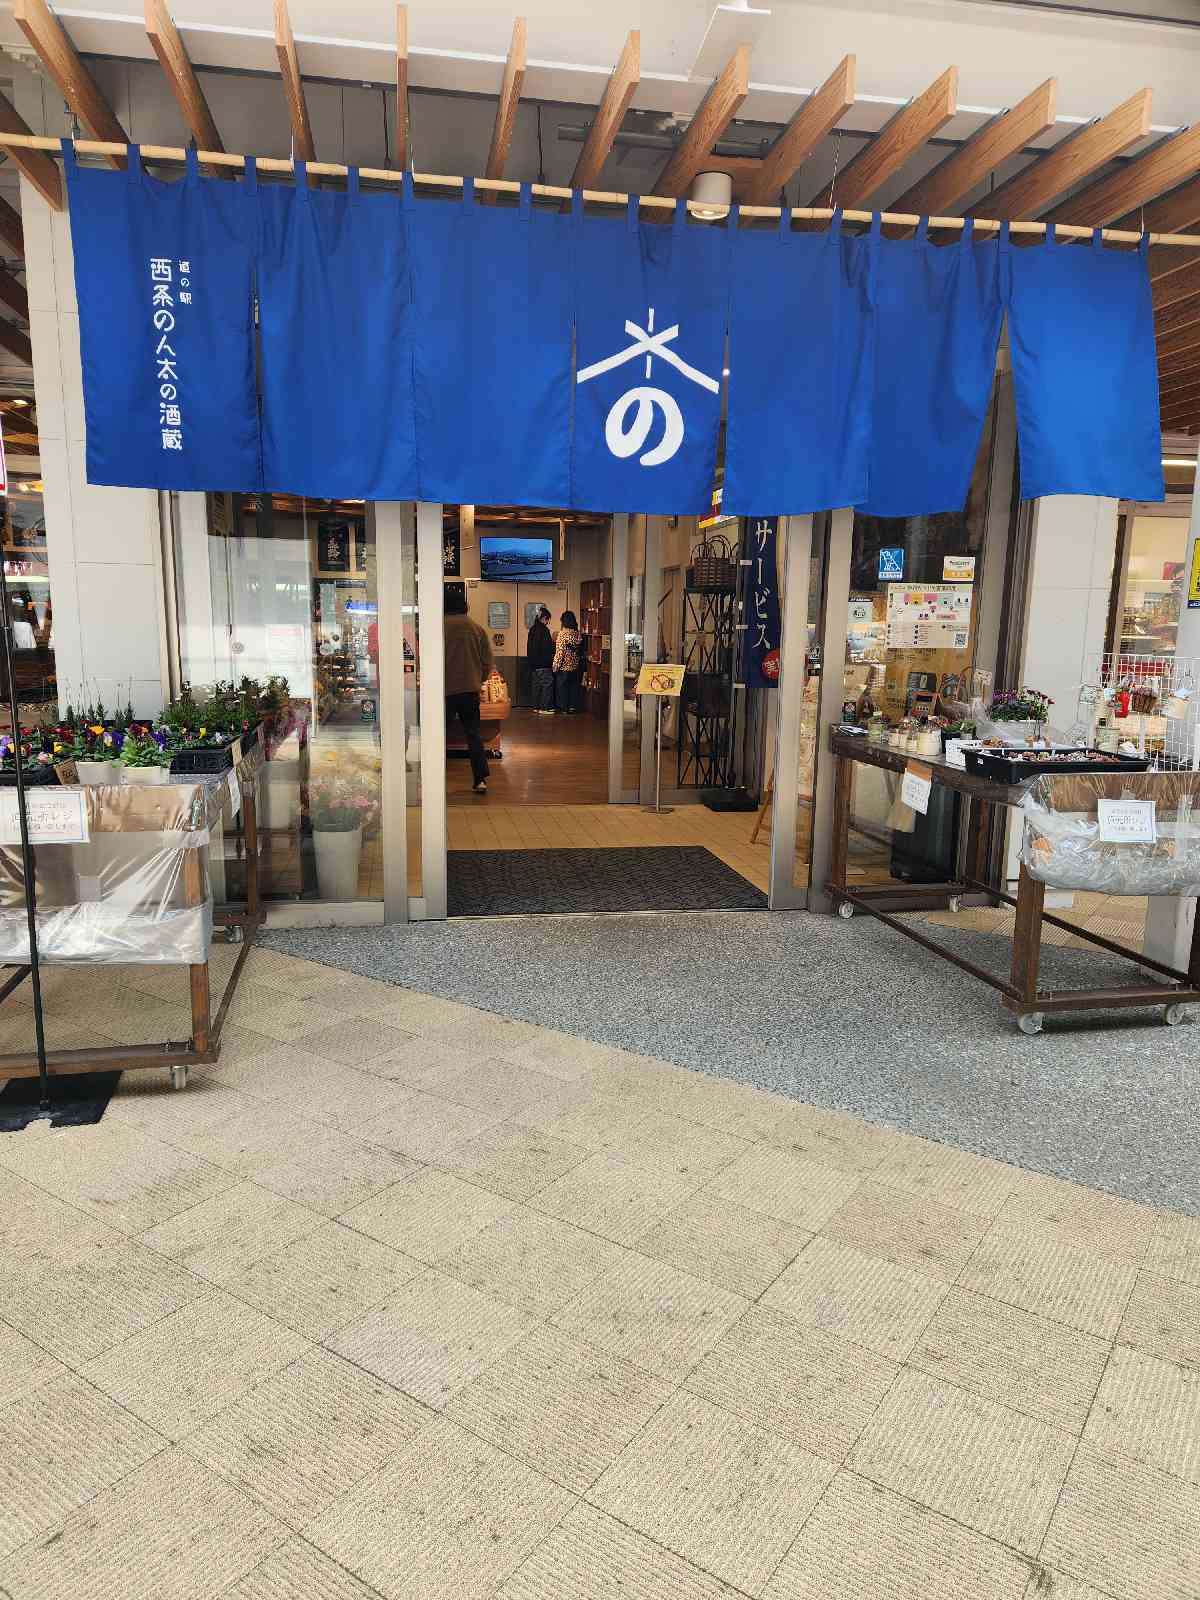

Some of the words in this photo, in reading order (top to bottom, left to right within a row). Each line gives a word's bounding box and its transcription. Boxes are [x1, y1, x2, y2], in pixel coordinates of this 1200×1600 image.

[178, 260, 192, 305] 道の駅
[752, 519, 772, 649] サービス
